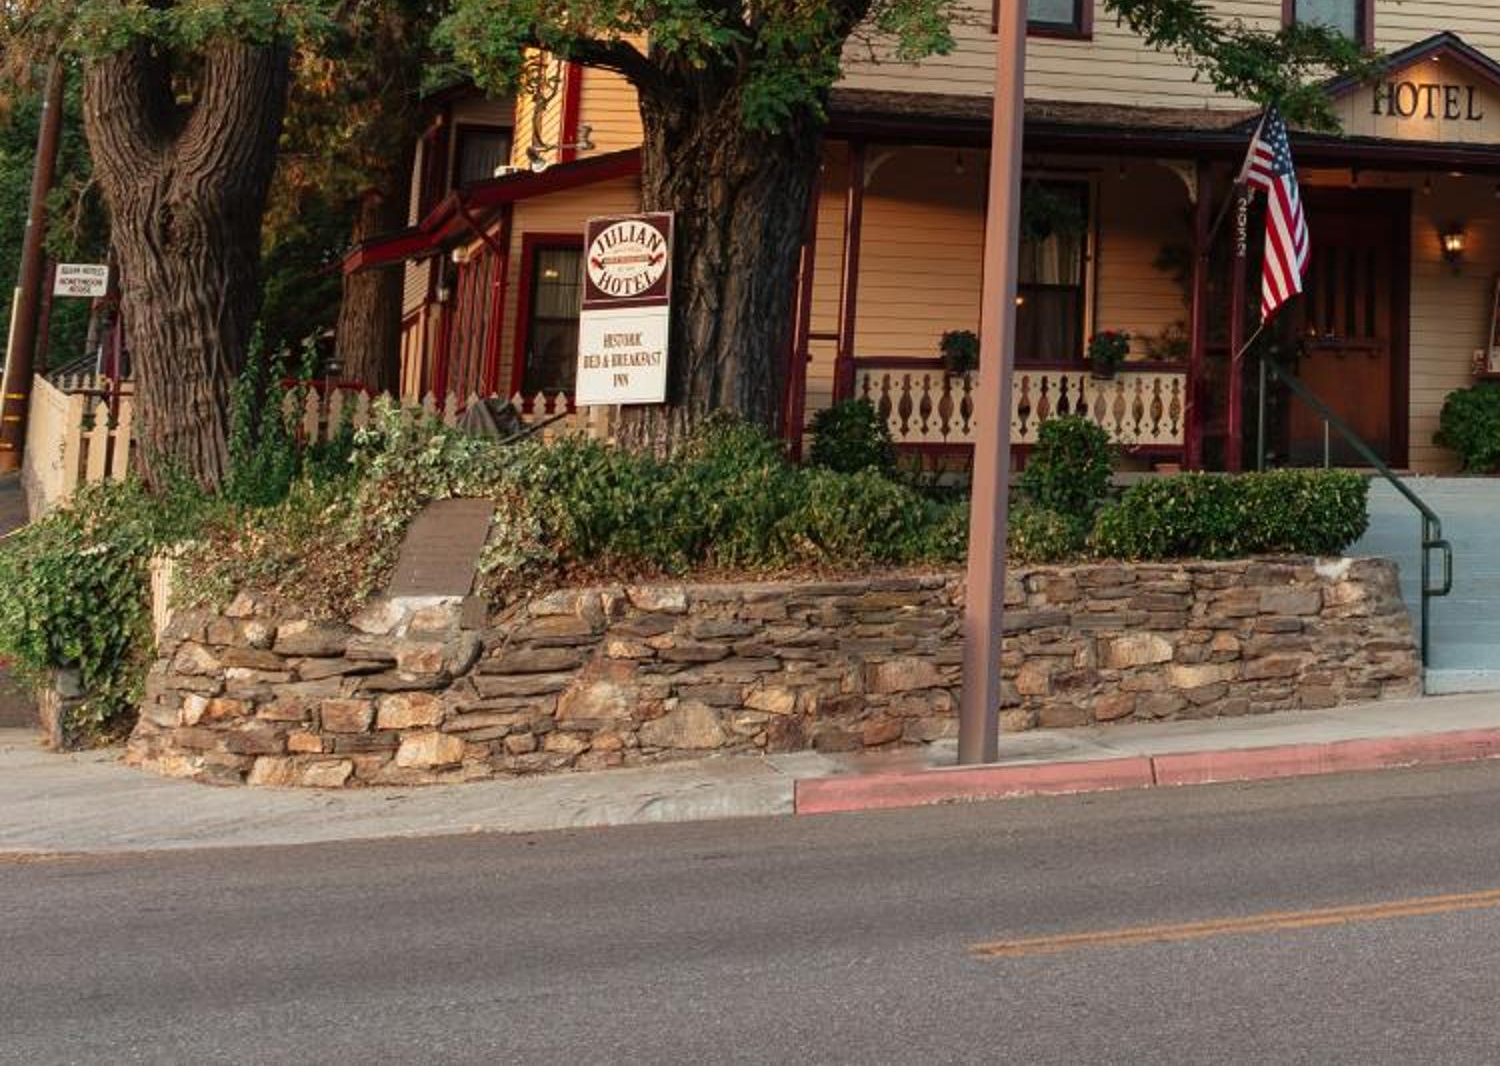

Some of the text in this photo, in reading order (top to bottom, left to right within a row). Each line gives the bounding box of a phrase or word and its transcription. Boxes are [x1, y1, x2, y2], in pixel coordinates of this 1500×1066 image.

[1371, 80, 1485, 121] HOTEL
[597, 225, 662, 256] JULIAN
[598, 272, 656, 294] HOTEL
[603, 333, 643, 348] HISTORIC
[583, 351, 662, 369] BED & BREAKFAST
[613, 373, 630, 388] INN
